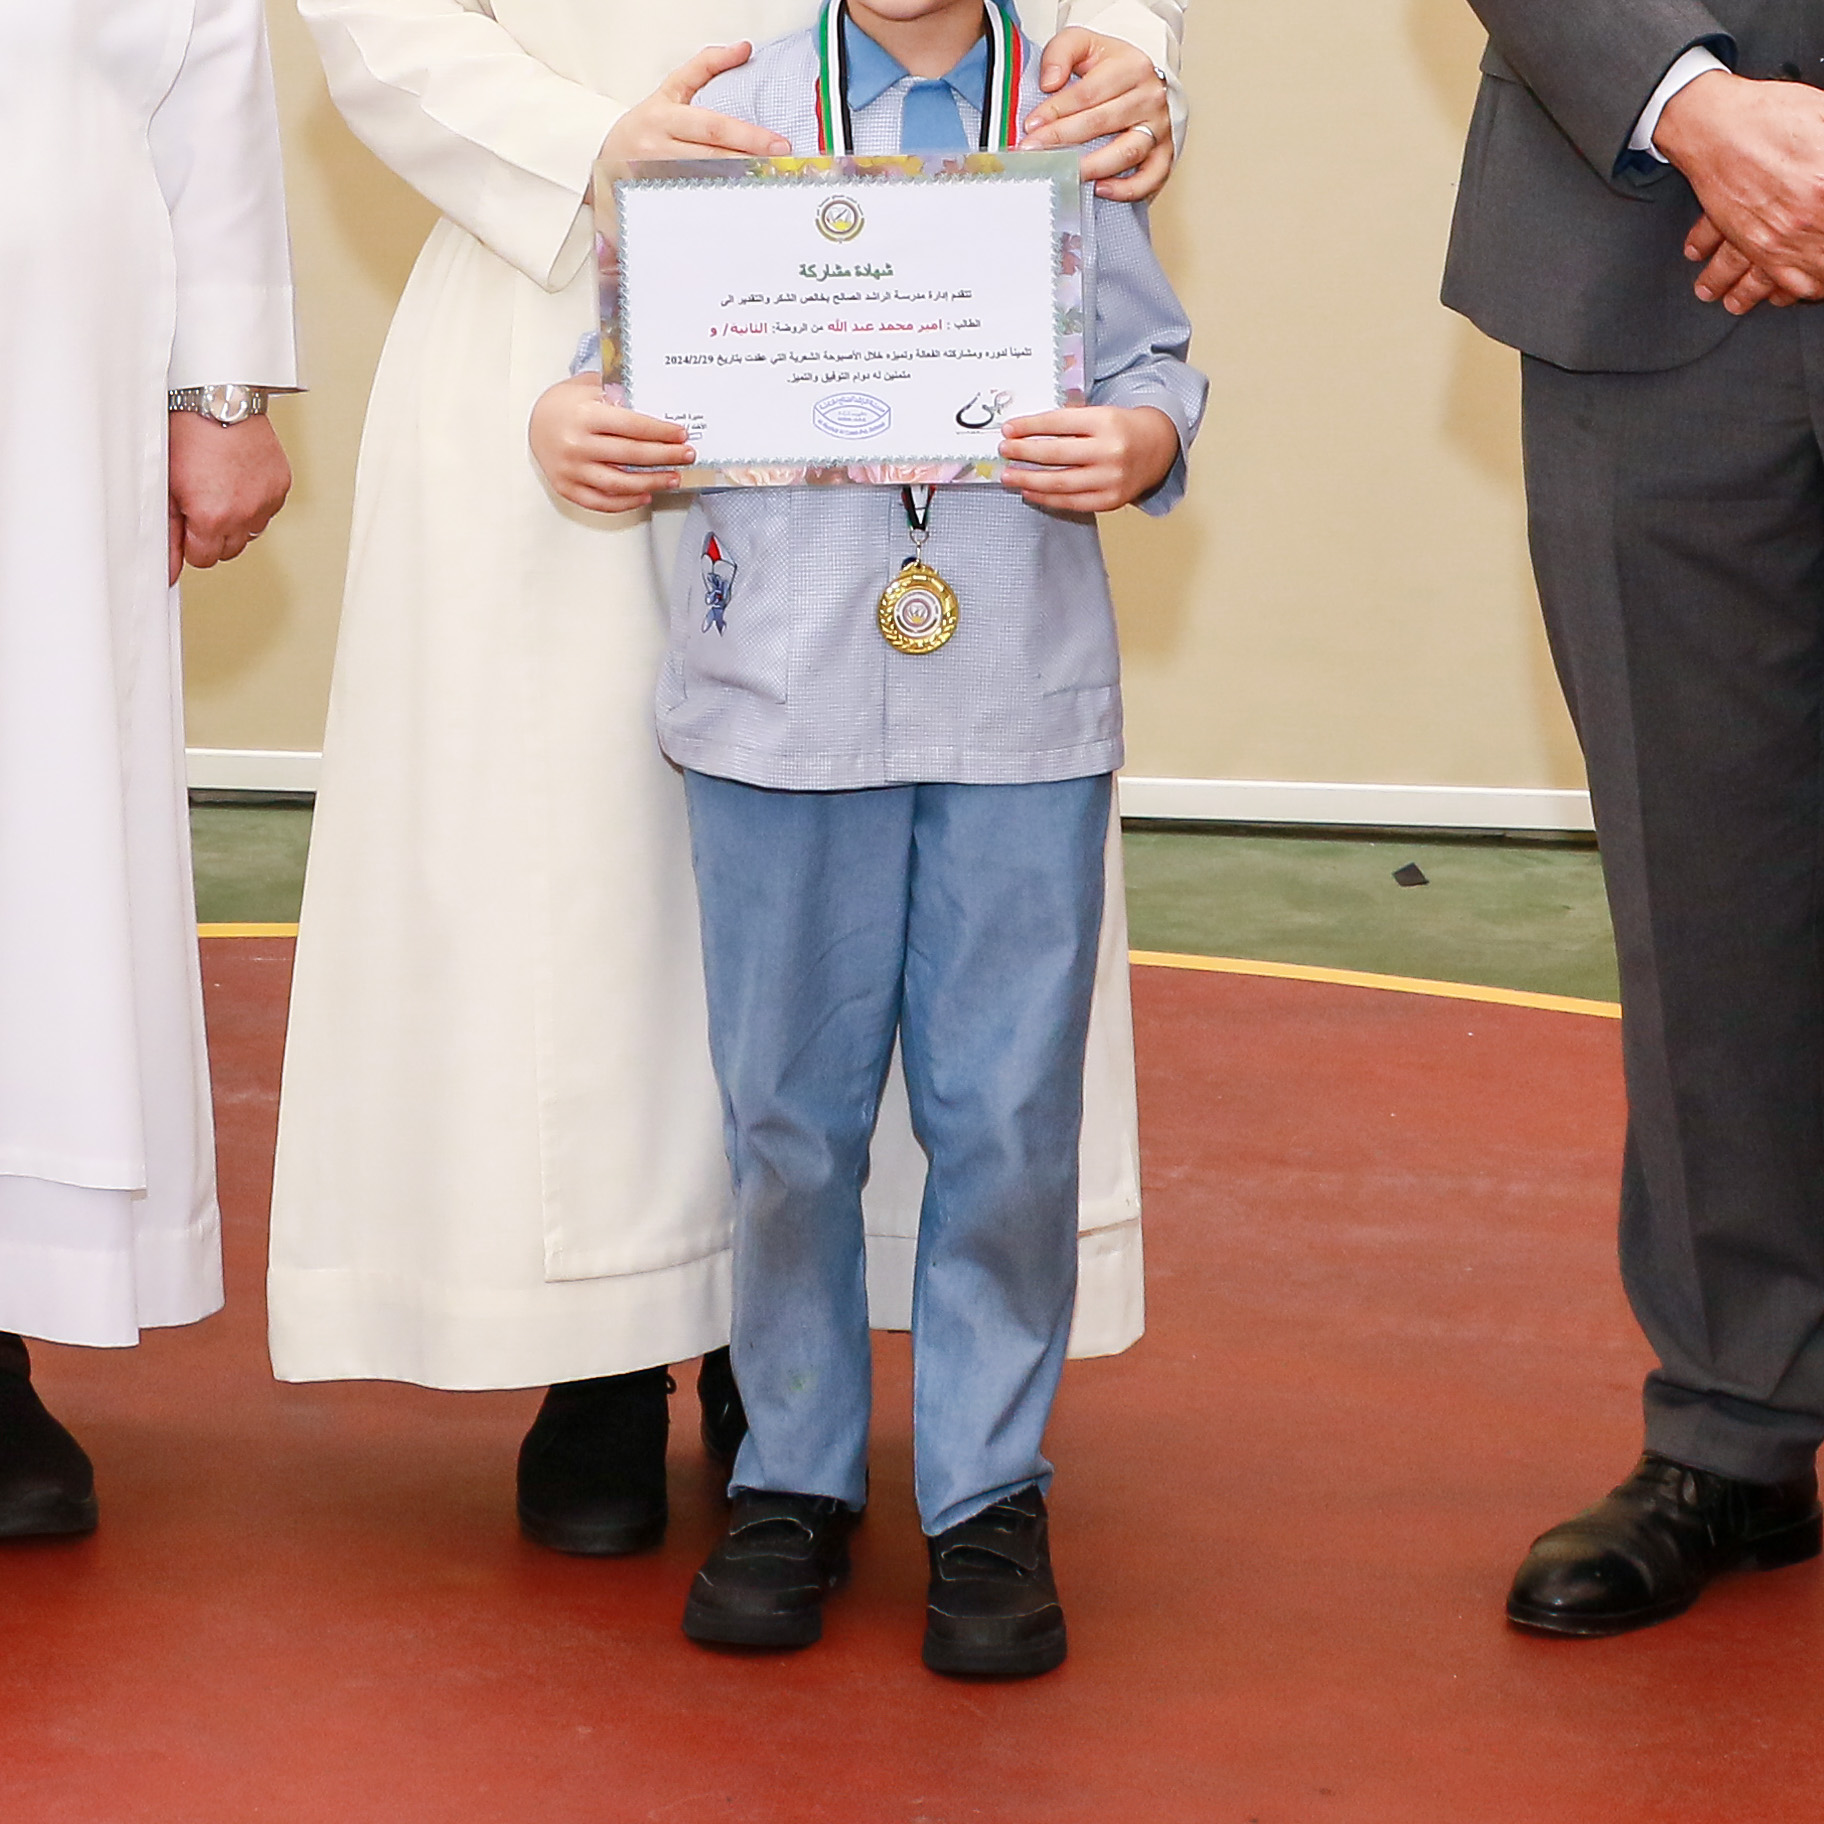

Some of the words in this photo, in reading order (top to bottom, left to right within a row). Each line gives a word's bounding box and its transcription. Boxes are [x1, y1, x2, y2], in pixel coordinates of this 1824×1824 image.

[799, 263, 852, 282] مشاركة
[855, 263, 894, 280] شهادة
[894, 289, 926, 302] مدرسة
[811, 324, 823, 334] من
[828, 318, 847, 333] الله
[852, 322, 874, 332] عبد
[878, 322, 913, 331] محمد
[665, 355, 715, 366] 2024/2/29
